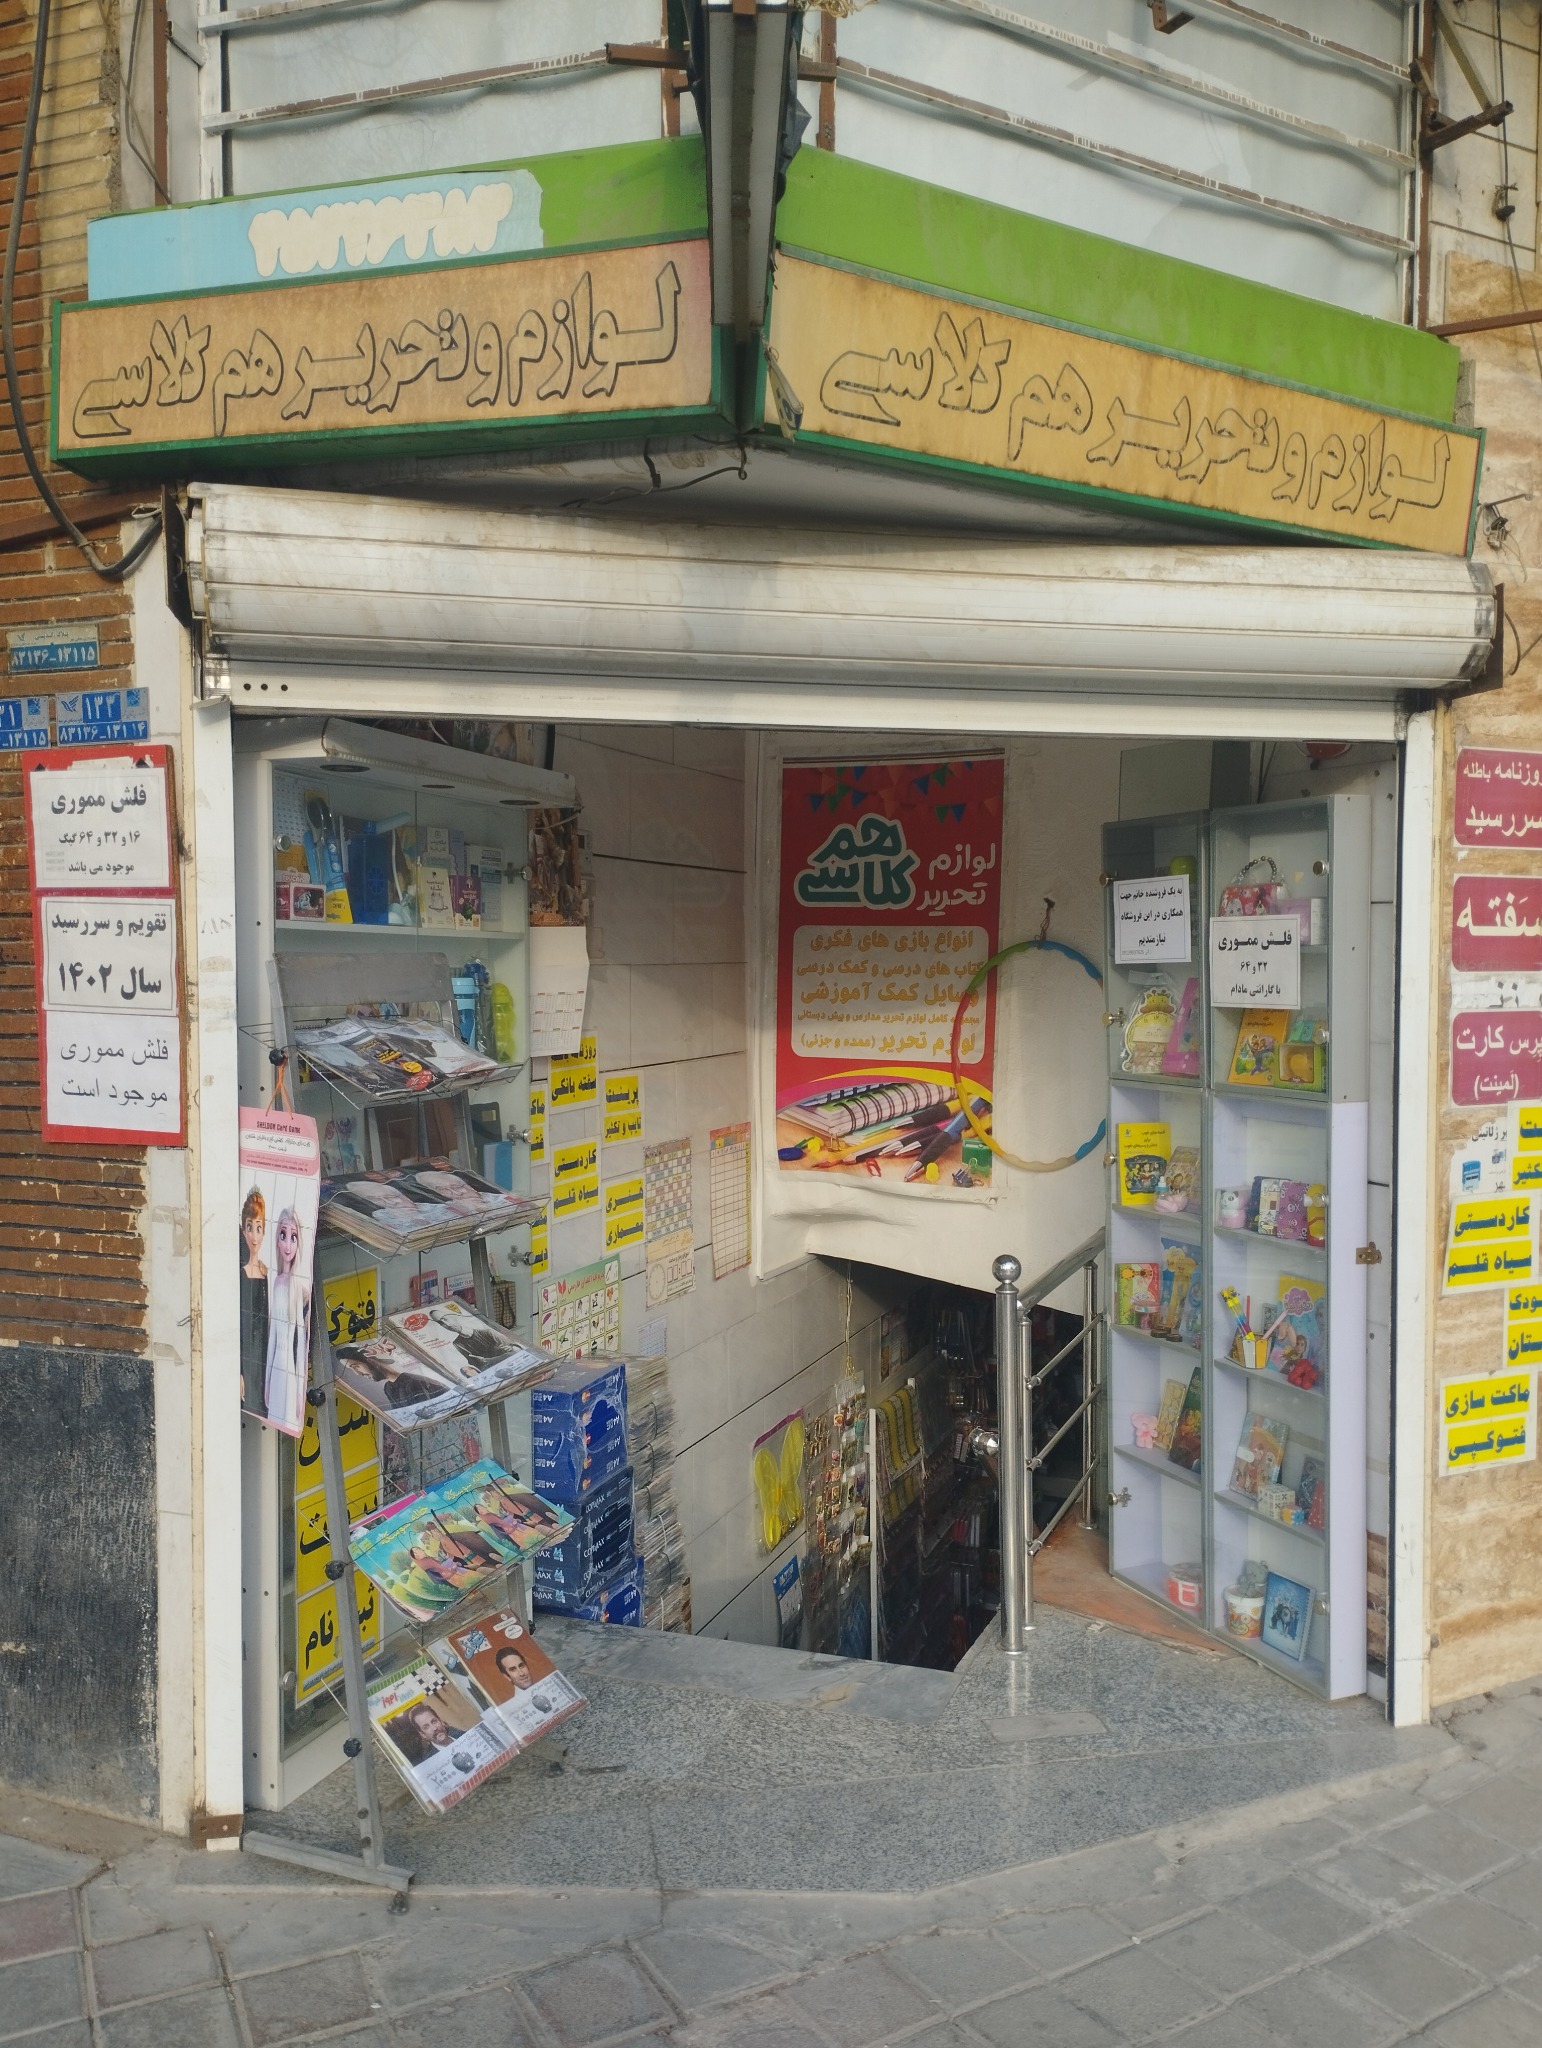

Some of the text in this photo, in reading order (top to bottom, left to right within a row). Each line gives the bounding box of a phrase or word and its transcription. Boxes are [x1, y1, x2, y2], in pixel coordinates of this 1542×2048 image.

[508, 260, 682, 407] لوازم
[72, 314, 212, 439] کلاسی
[819, 310, 1012, 427] کلاسی
[213, 328, 285, 437] هم
[1007, 362, 1094, 462] هم
[1306, 418, 1451, 521] لوازم
[1463, 761, 1492, 783] باطله
[51, 784, 148, 816] فلش مموری
[58, 831, 141, 847] ۱۶ و ۳۲ و ۶۴ گیگ
[808, 815, 904, 865] هم
[68, 861, 88, 876] باشد
[90, 862, 104, 875] می
[105, 862, 135, 876] موجود
[929, 842, 996, 881] لوازم
[797, 854, 916, 906] کلاسی
[916, 882, 988, 917] تحریر
[1145, 886, 1166, 901] فروشنده
[115, 919, 124, 936] و
[128, 913, 168, 938] تقویم
[1120, 908, 1183, 924] همکاری در این فروشگاه
[810, 928, 974, 954] انواع بازی های فکری
[1138, 931, 1166, 947] نیازمندیم
[1218, 928, 1293, 952] فلش مموری
[796, 961, 834, 977] درسی
[838, 959, 869, 974] کمک
[871, 964, 879, 976] و
[882, 962, 921, 978] درسی
[925, 961, 950, 978] های
[1240, 961, 1268, 974] ۳۲ و ۶۴
[58, 962, 162, 1000] سال ۱۴۰۲
[800, 980, 873, 1004] آموزشی
[877, 981, 920, 1001] کمک
[1250, 984, 1275, 997] گارانتی
[1276, 984, 1281, 997] با
[882, 1012, 905, 1025] تحریر
[906, 1013, 927, 1025] لوازم
[928, 1013, 948, 1025] کامل
[834, 1037, 842, 1049] و
[878, 1031, 928, 1054] تحریر
[932, 1031, 976, 1056] لوزم
[1456, 1024, 1505, 1057] کارت
[60, 1039, 170, 1066] فلش مموری
[61, 1077, 169, 1108] موجود است
[551, 1073, 597, 1101] سفته بانکی
[606, 1086, 639, 1106] پرینت
[530, 1098, 545, 1115] ماک
[605, 1116, 642, 1138] تایپ و تکثیر
[1512, 1162, 1542, 1185] کثیر
[554, 1188, 576, 1216] قلم
[605, 1221, 643, 1246] معماری
[1448, 1250, 1532, 1283] سیاه قلم
[1509, 1293, 1542, 1313] ودک
[1445, 1382, 1530, 1419] ماکت سازی
[1448, 1424, 1527, 1461] فتوکپی
[305, 1610, 334, 1670] نام
